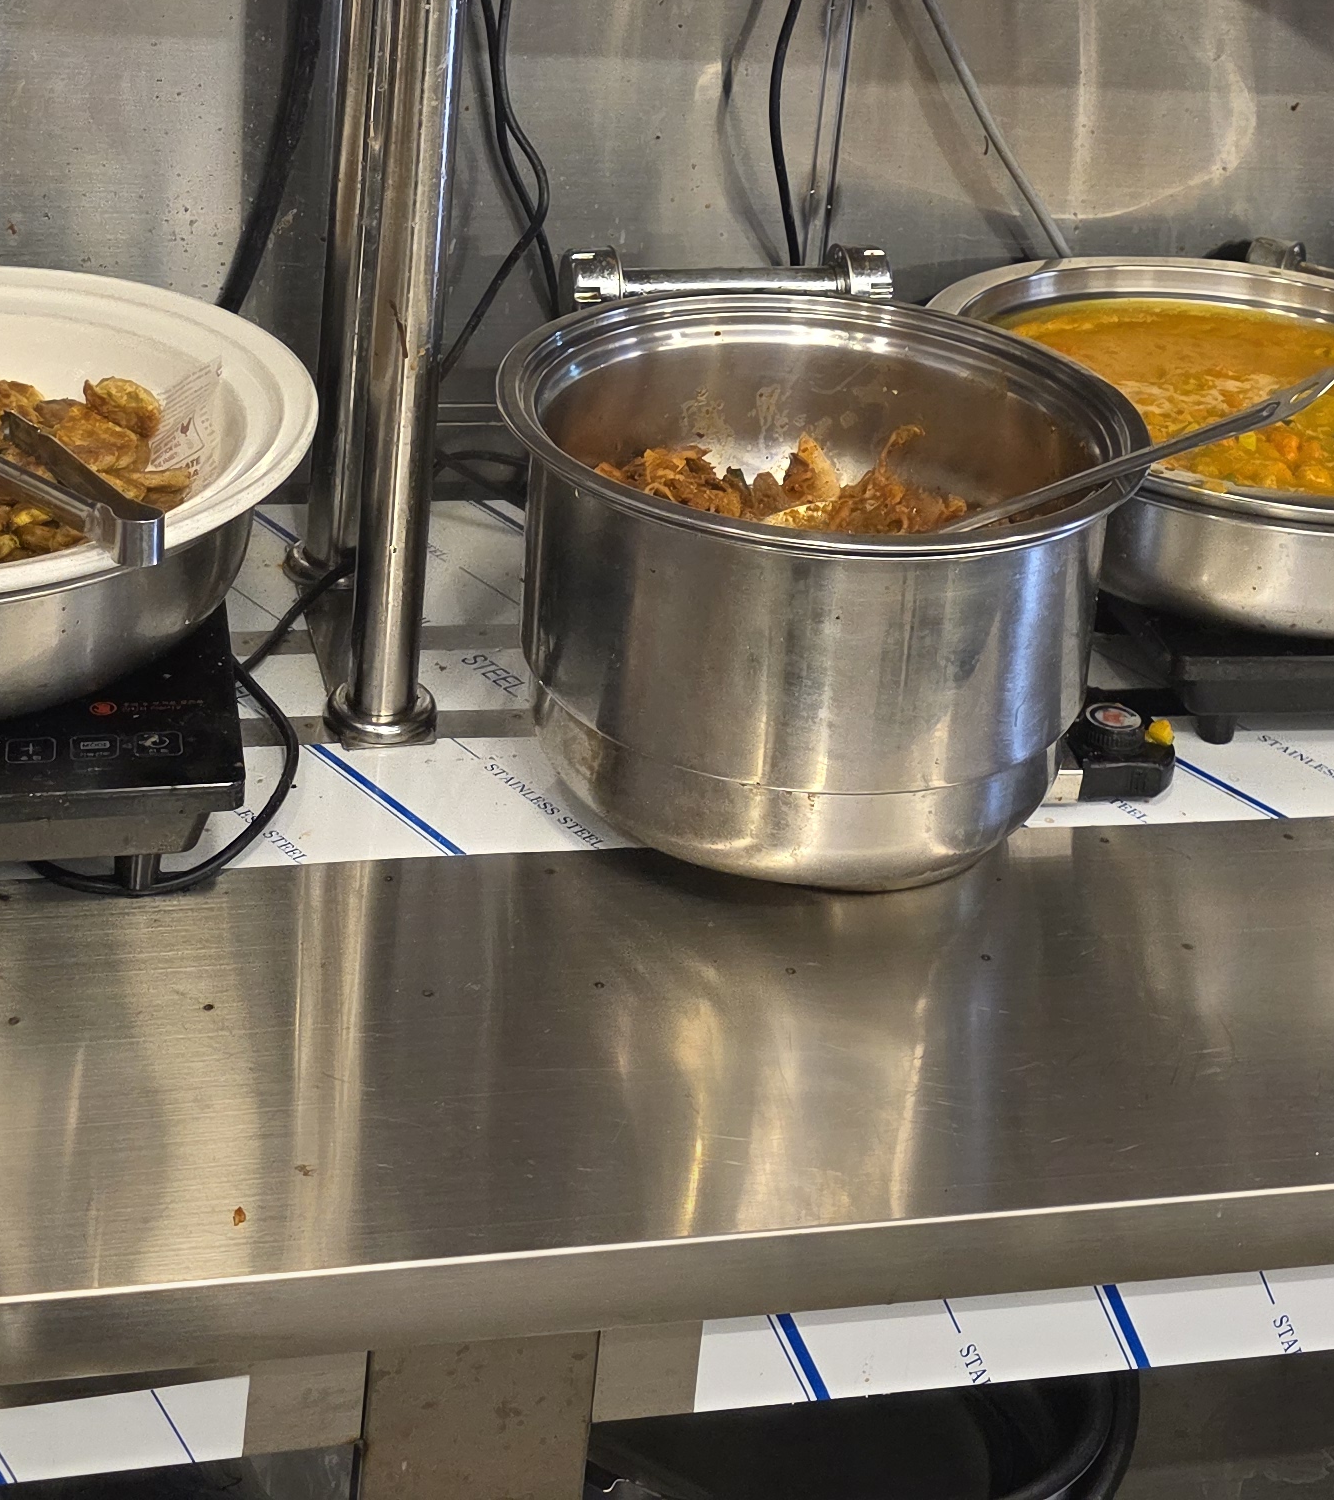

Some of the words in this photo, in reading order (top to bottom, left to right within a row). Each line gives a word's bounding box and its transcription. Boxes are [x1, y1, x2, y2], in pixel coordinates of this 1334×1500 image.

[461, 653, 526, 697] STEEL
[484, 762, 560, 817] STAINLESS
[557, 815, 605, 850] STEEL
[263, 829, 308, 863] STEEL
